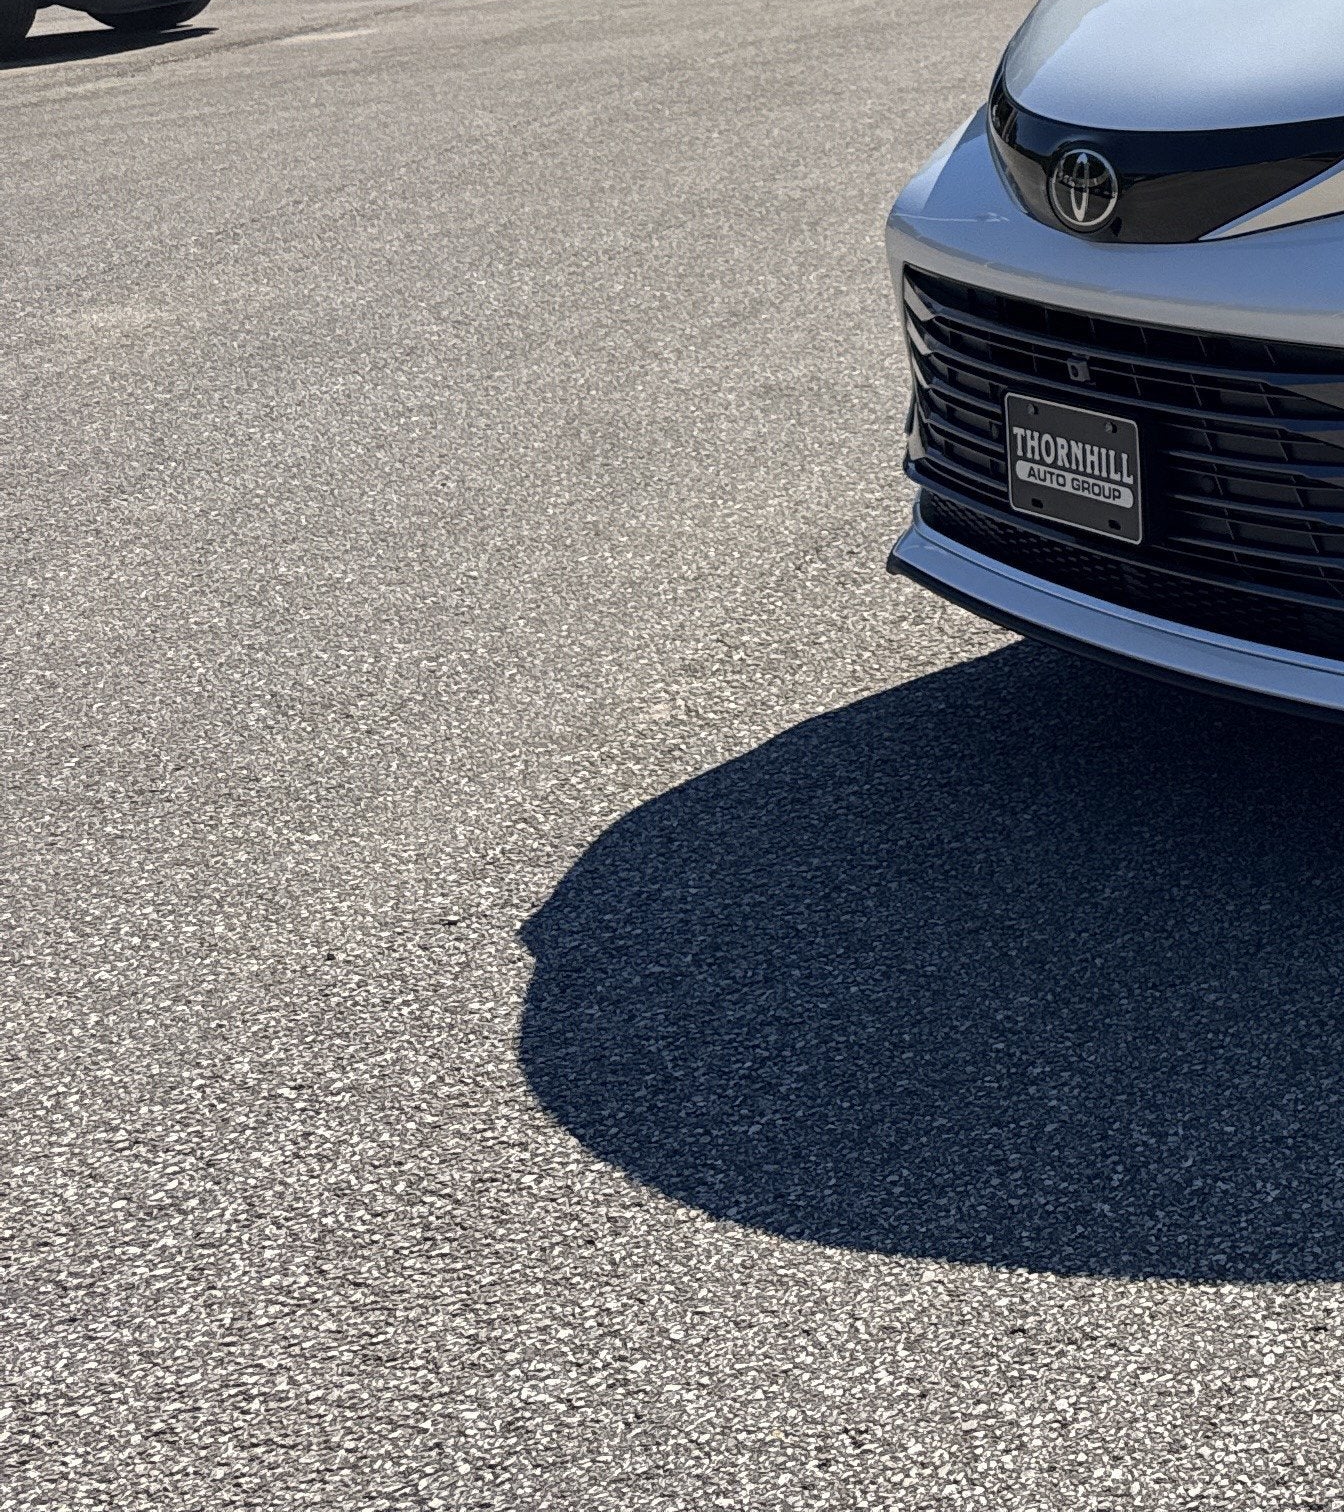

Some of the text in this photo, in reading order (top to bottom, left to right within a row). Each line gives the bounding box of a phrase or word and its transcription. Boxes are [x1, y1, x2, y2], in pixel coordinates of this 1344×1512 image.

[1012, 426, 1134, 485] THORNHILL
[1027, 466, 1122, 502] AUTO GROUP
